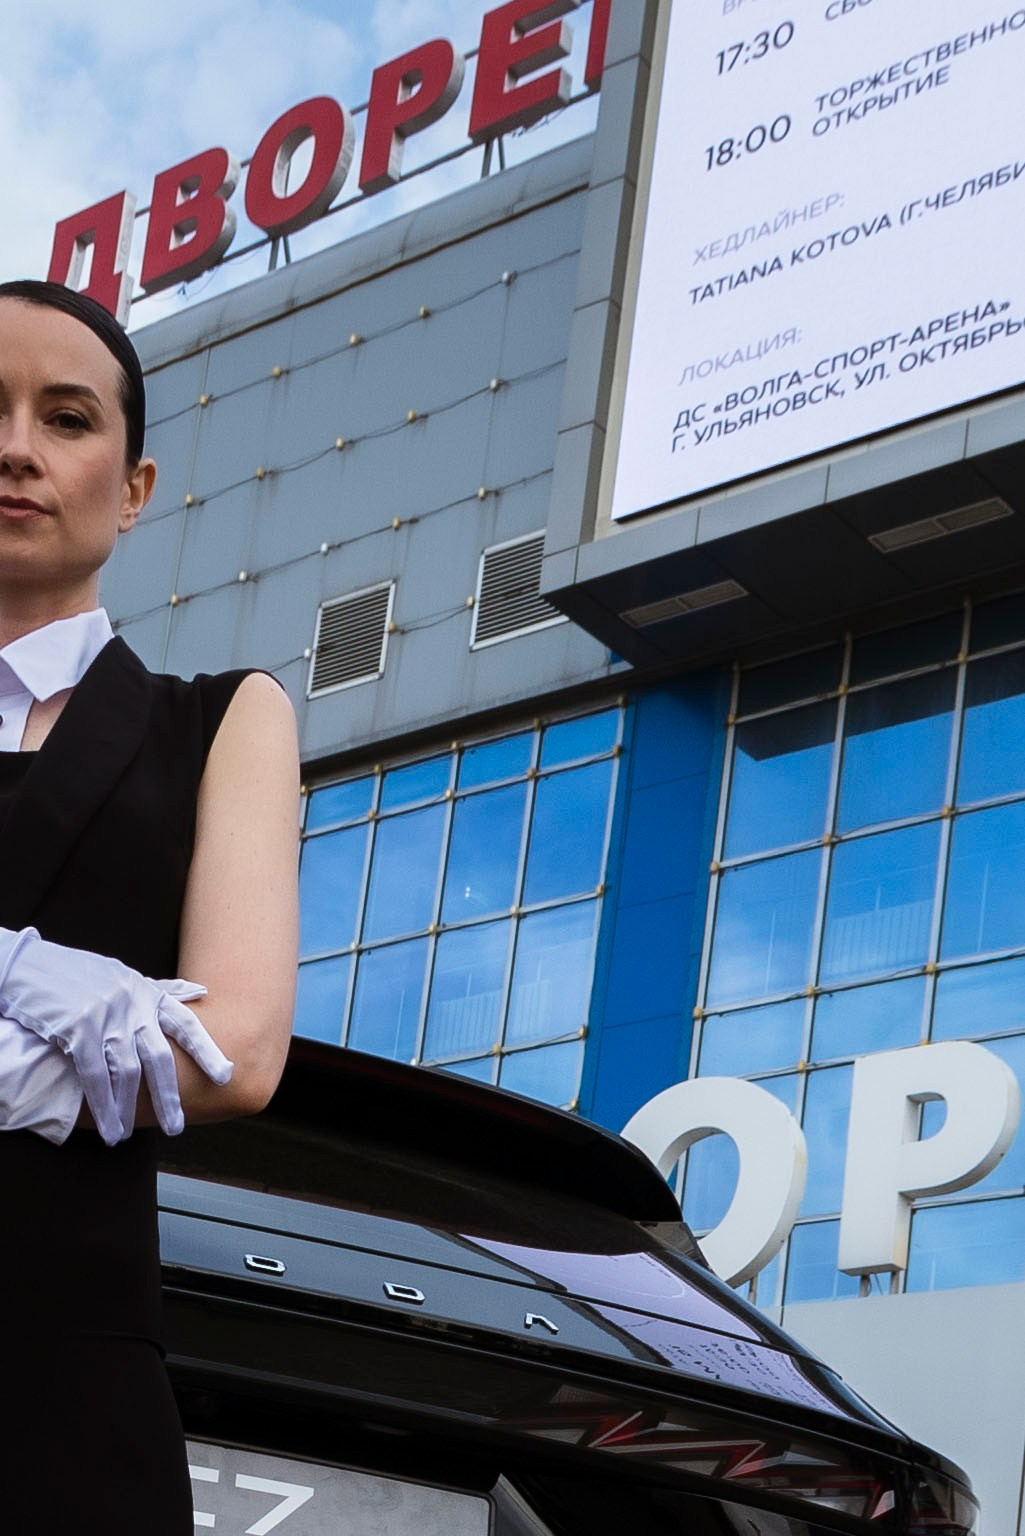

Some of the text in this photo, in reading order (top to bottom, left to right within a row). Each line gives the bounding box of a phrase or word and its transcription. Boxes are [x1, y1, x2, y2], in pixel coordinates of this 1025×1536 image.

[715, 20, 795, 76] 17:30
[815, 9, 1025, 113] ТОРЖЕСТВЕННО
[704, 114, 792, 171] 18:00
[812, 65, 951, 137] ОТКРЫТИЕ
[46, 0, 612, 330] ДВОРЕ
[689, 256, 783, 305] TATIANA
[790, 213, 891, 267] KOTOVA
[692, 192, 846, 266] ХЕДЛАЙНЕР:
[672, 317, 1025, 453] Г. УЛЬЯНОВСК, УЛ. ОКТЯБРЬ
[673, 300, 1010, 433] ДС «ВОЛГА-СПОРТ-АРЕНА»
[677, 326, 803, 386] ЛОКАЦИЯ:
